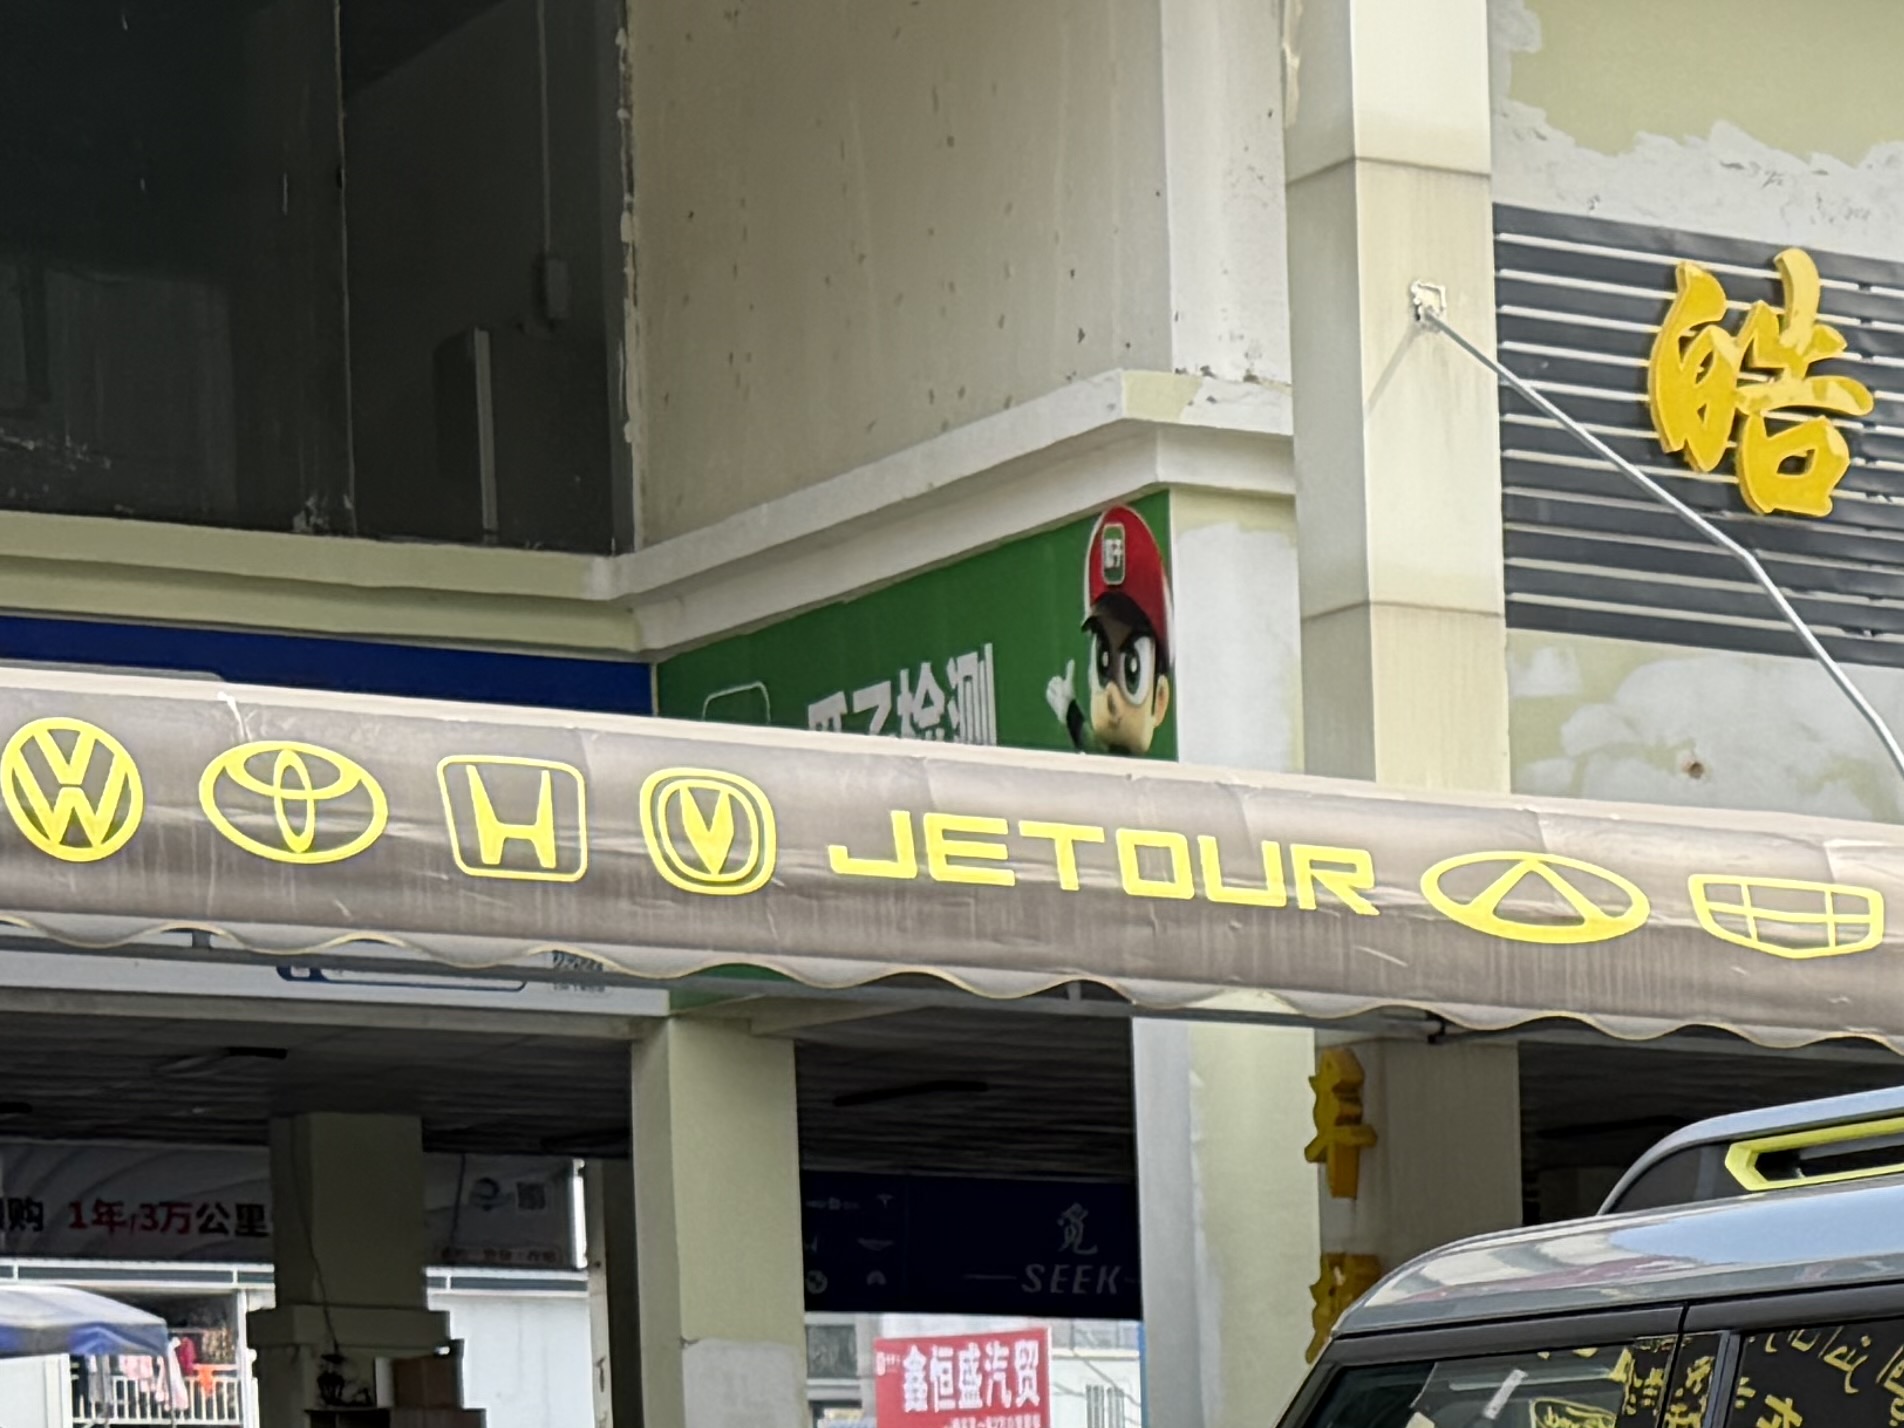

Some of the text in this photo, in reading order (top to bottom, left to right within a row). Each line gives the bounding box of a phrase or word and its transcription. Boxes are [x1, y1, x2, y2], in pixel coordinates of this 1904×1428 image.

[828, 810, 1380, 916] JETOUR
[1022, 1263, 1122, 1296] SEEK
[902, 1339, 1041, 1414] 鑫恒盛汽贸
